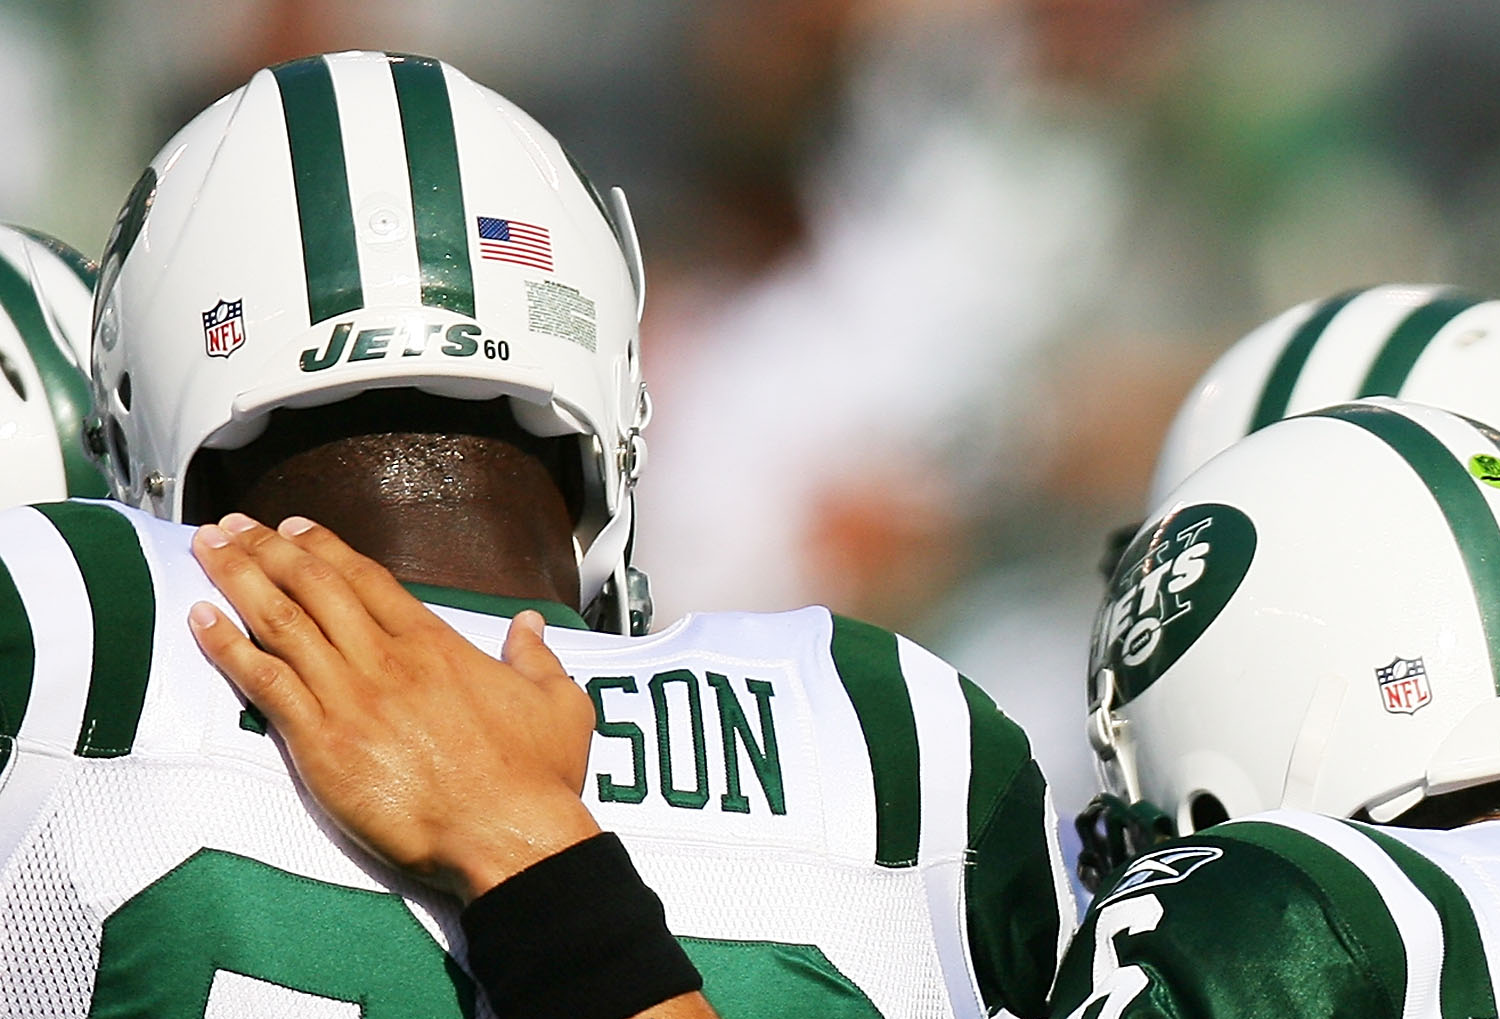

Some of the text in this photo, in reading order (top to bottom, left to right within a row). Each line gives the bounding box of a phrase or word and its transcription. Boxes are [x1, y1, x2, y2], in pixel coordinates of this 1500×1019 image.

[208, 320, 242, 352] NFL
[299, 321, 509, 373] JETS 60
[1384, 678, 1428, 708] NFL
